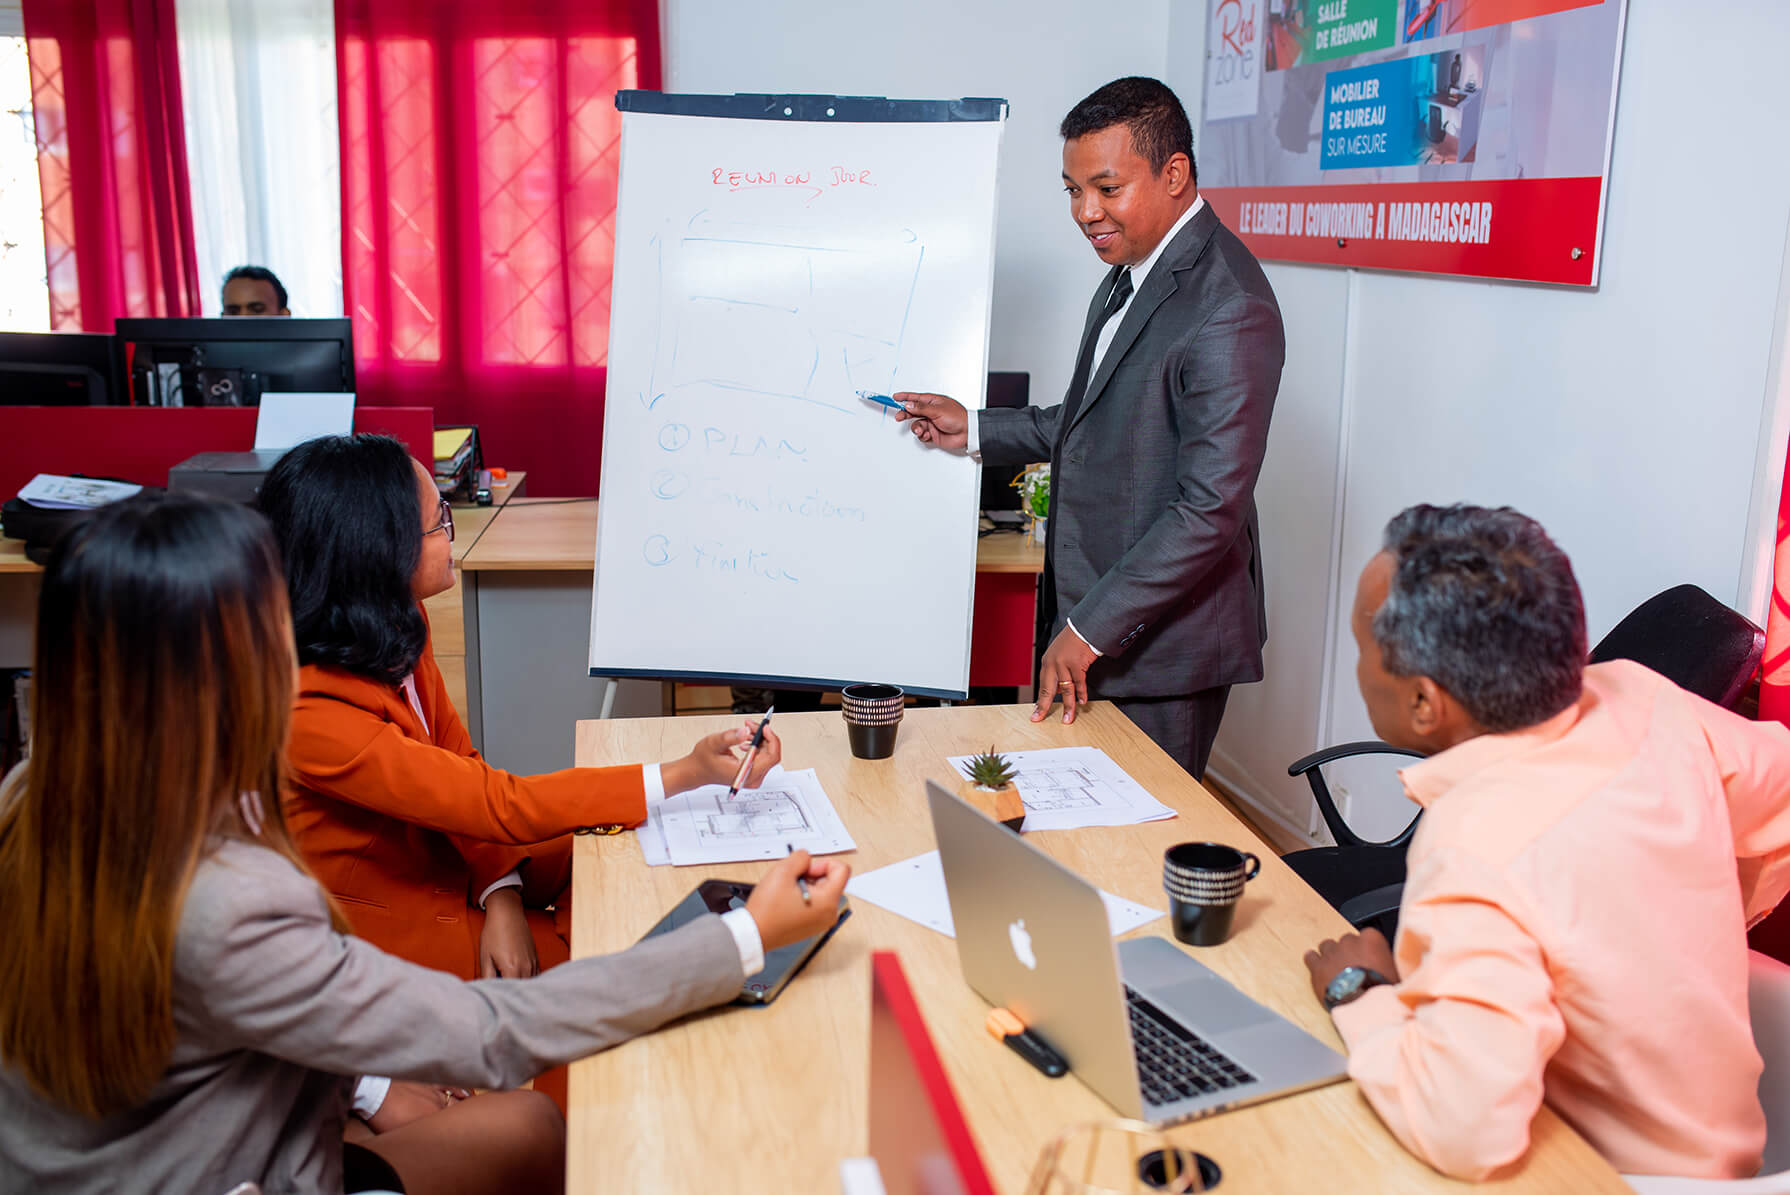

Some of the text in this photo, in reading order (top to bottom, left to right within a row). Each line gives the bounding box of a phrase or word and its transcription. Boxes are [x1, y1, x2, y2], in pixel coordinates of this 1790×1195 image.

[1317, 0, 1347, 24] SALLE
[1316, 18, 1378, 50] DE RÉUNION
[1330, 78, 1380, 104] MOBILIER
[1329, 104, 1386, 131] DE BUREAU
[1327, 133, 1387, 156] SUR MESURE
[1240, 202, 1493, 244] LE LEADER DU COWORKING A MADAGASCAR
